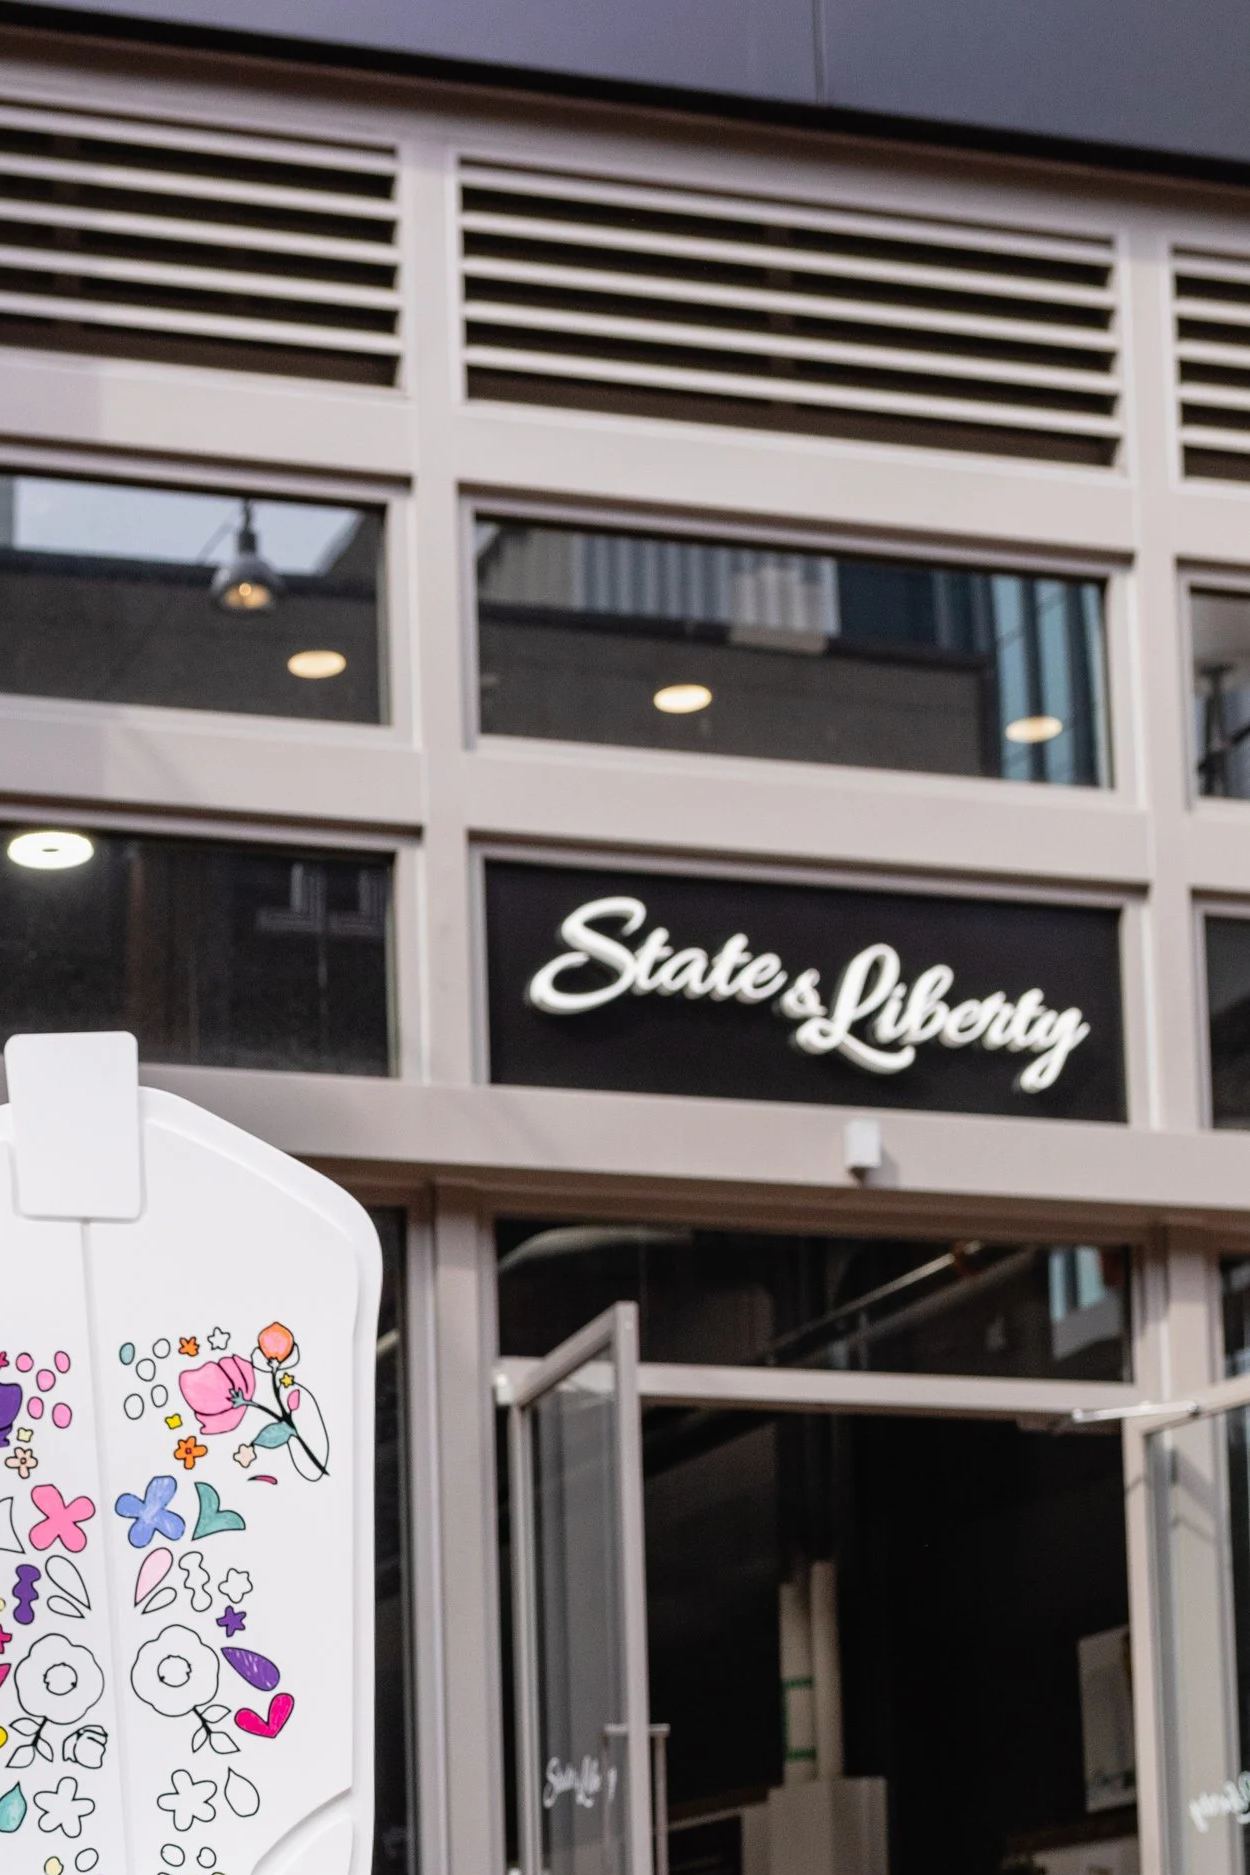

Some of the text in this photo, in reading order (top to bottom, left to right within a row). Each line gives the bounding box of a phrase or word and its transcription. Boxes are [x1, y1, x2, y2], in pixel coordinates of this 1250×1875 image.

[529, 896, 1091, 1093] State & Liberty
